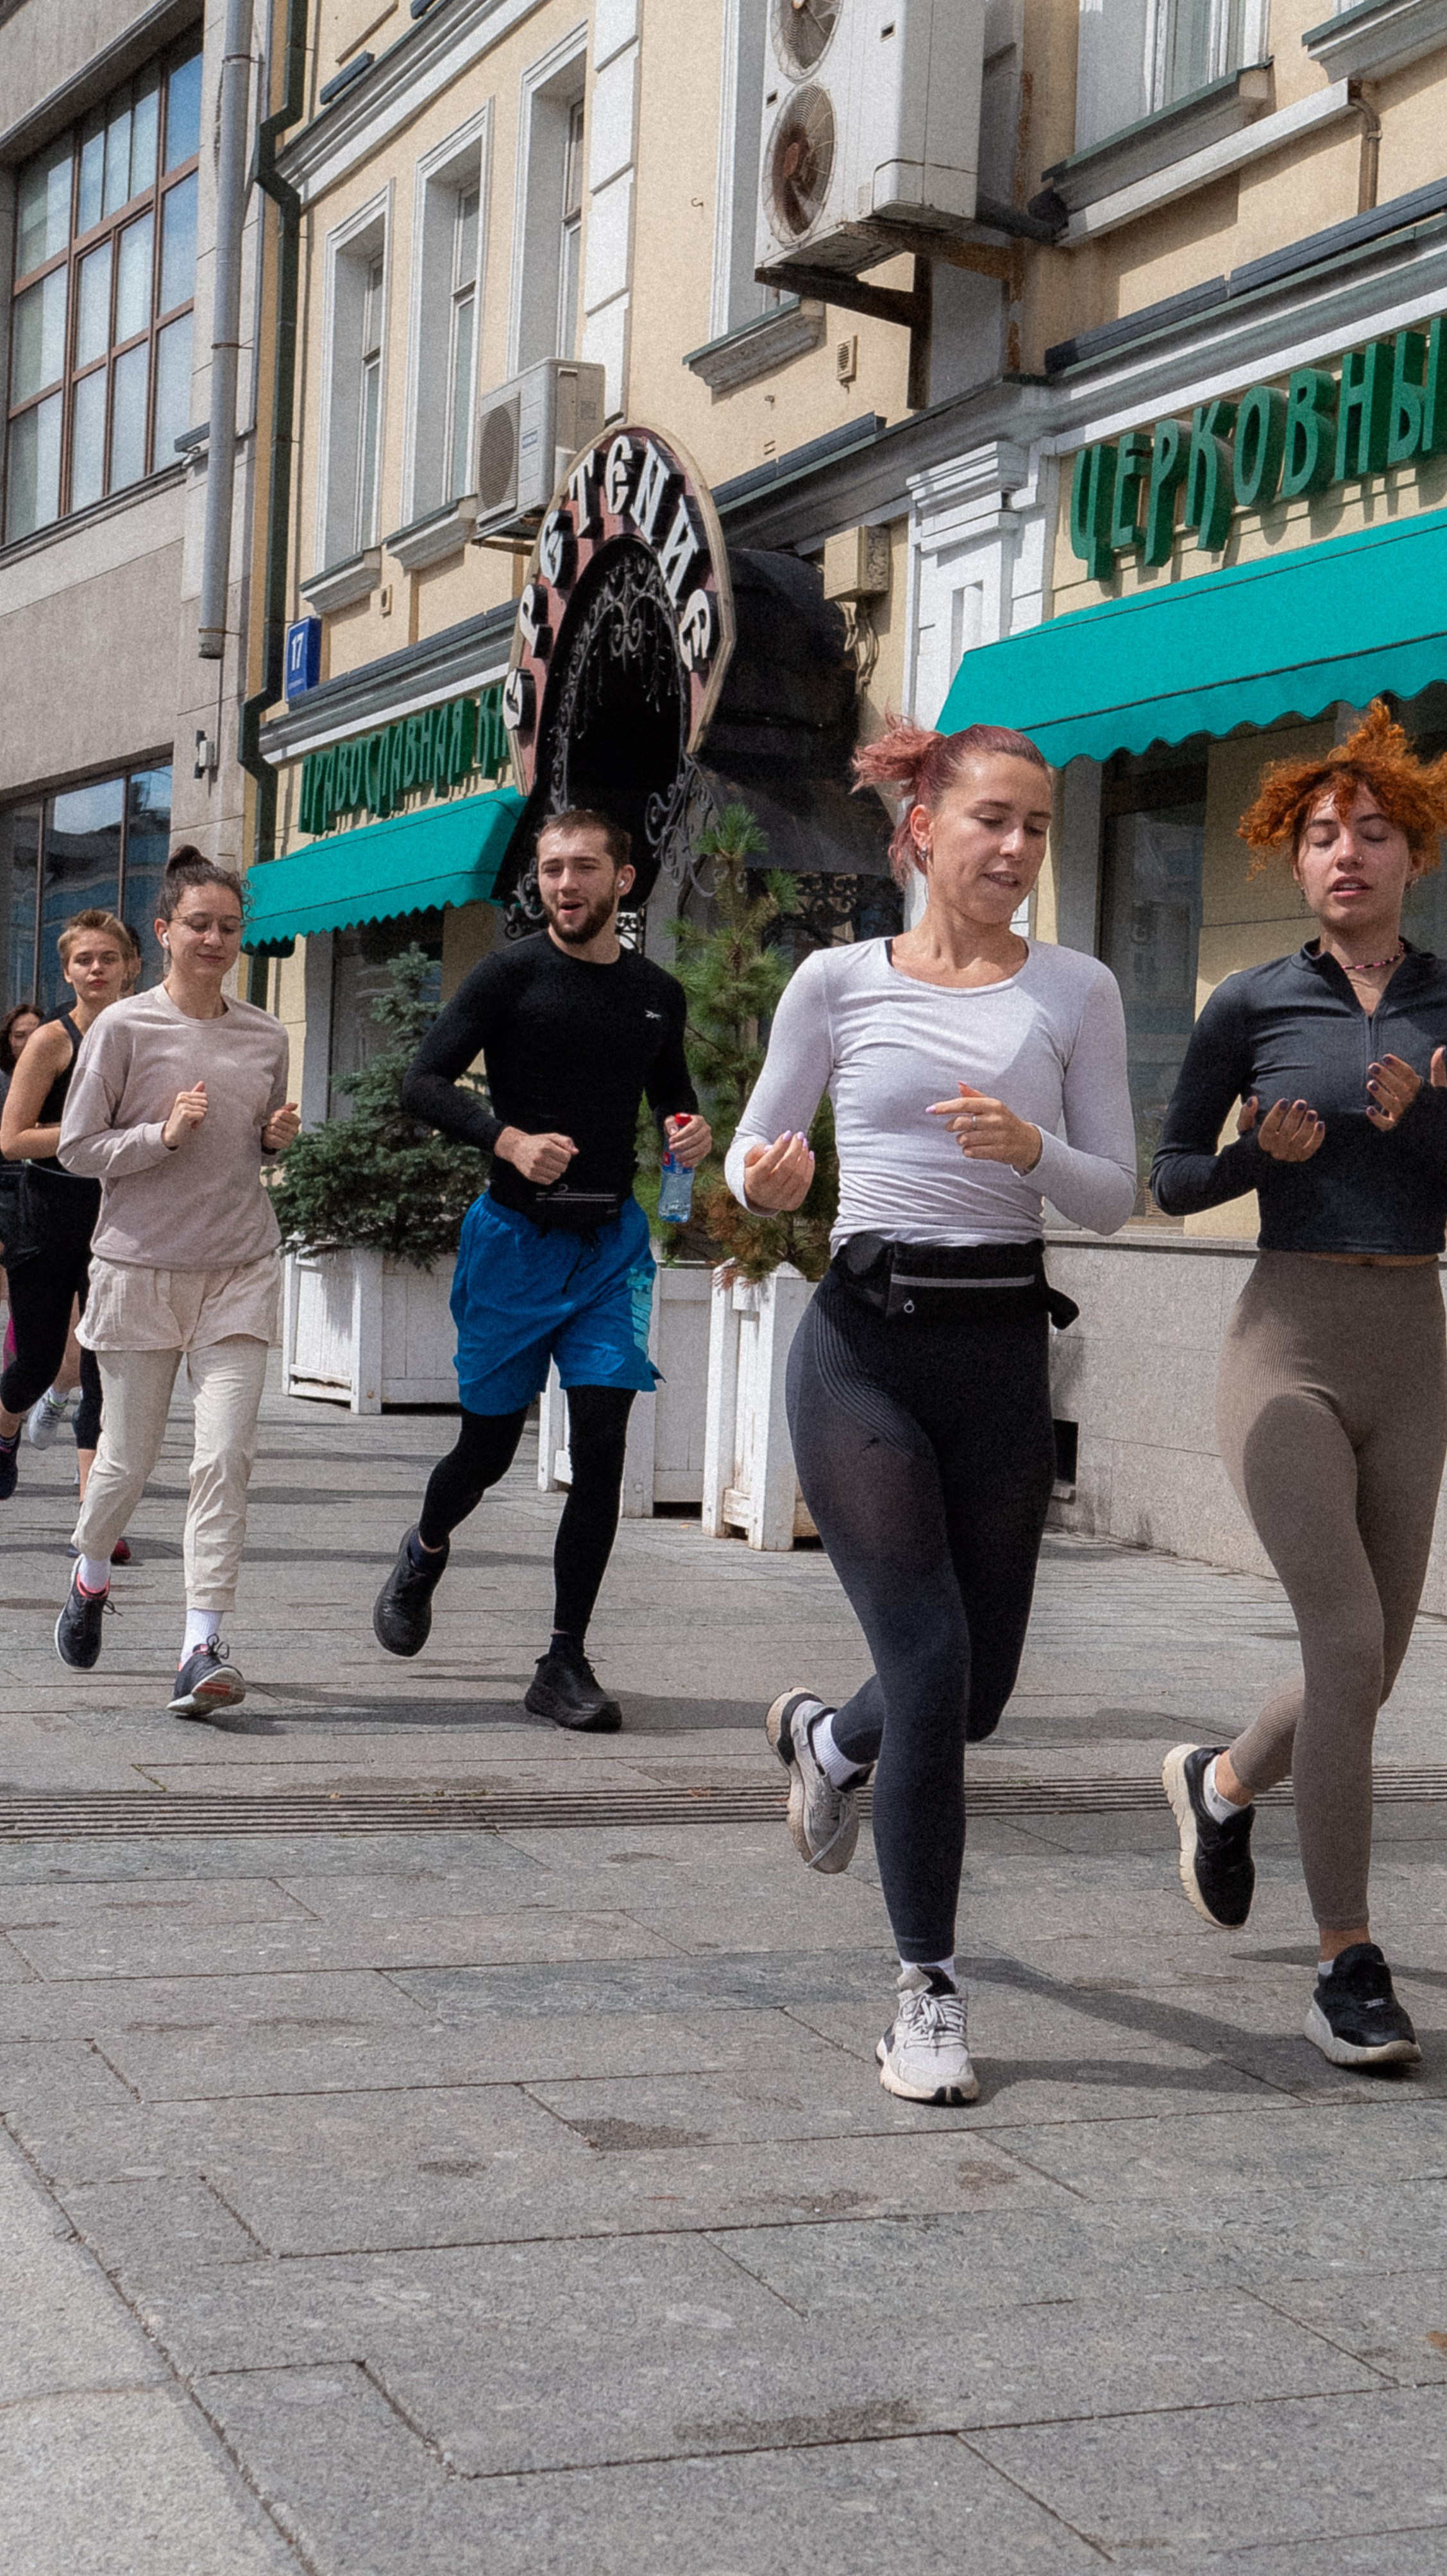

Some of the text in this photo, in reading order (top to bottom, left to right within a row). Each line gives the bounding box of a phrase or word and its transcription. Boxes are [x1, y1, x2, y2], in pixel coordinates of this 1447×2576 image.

[1070, 317, 1444, 580] ЦЕРКОВНЫ
[291, 632, 305, 672] 17
[298, 684, 507, 834] ПРАВОСЛАВНАЯ КН
